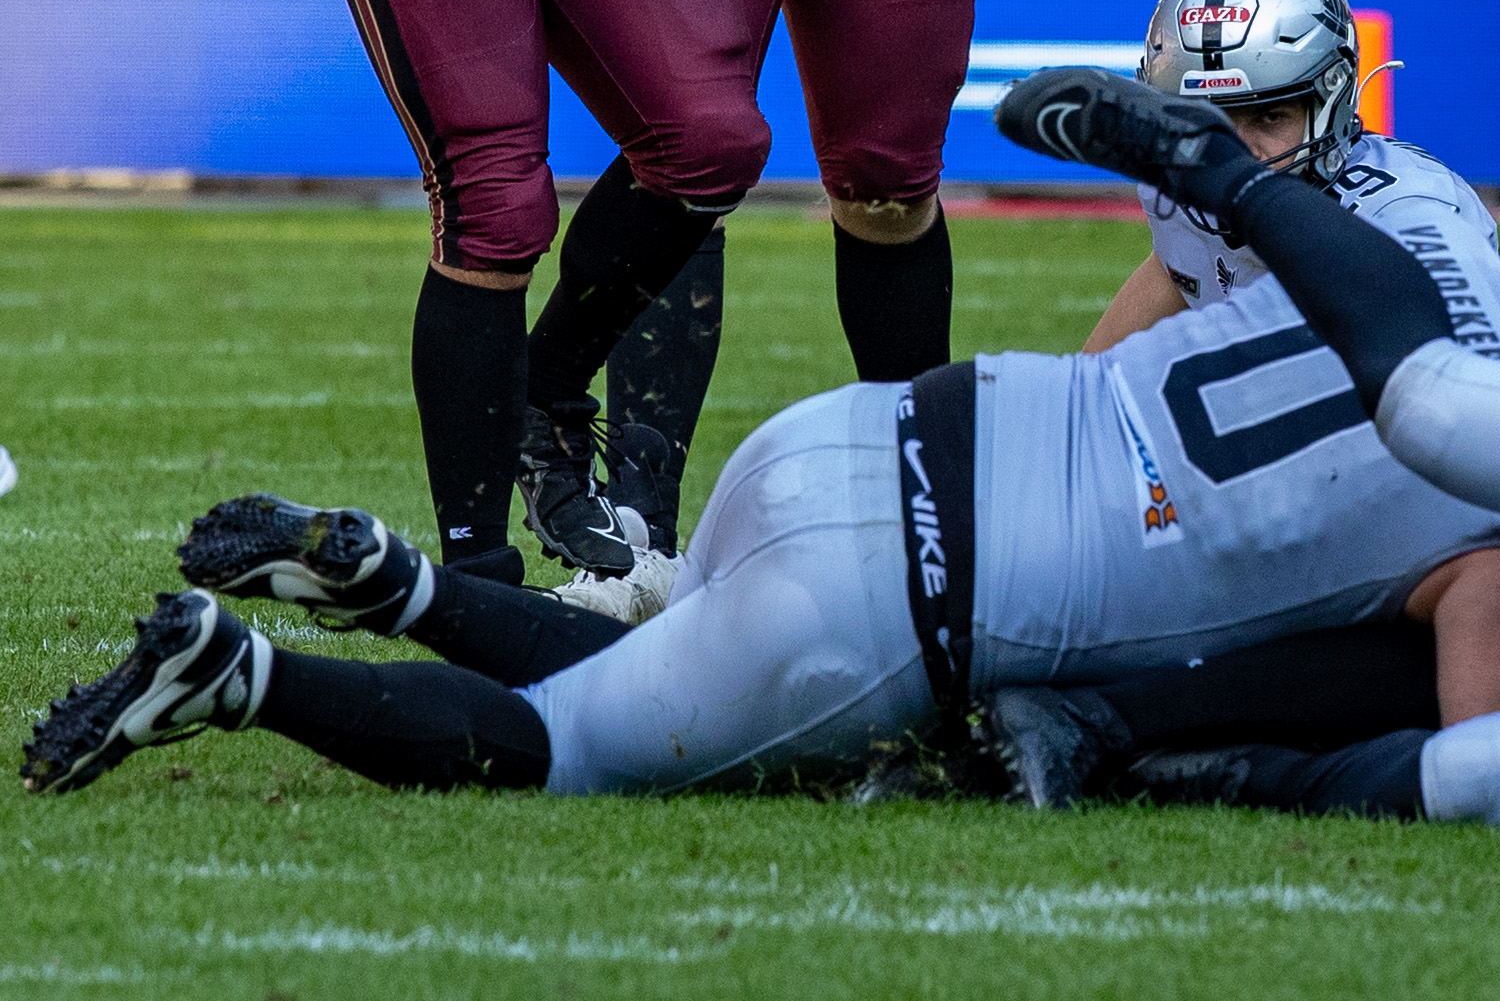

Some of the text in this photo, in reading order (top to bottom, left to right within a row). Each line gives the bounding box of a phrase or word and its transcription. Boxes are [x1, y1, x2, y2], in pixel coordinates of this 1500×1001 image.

[1185, 6, 1243, 24] GAZI
[1210, 79, 1239, 88] GAZI
[911, 491, 948, 598] NIKE
